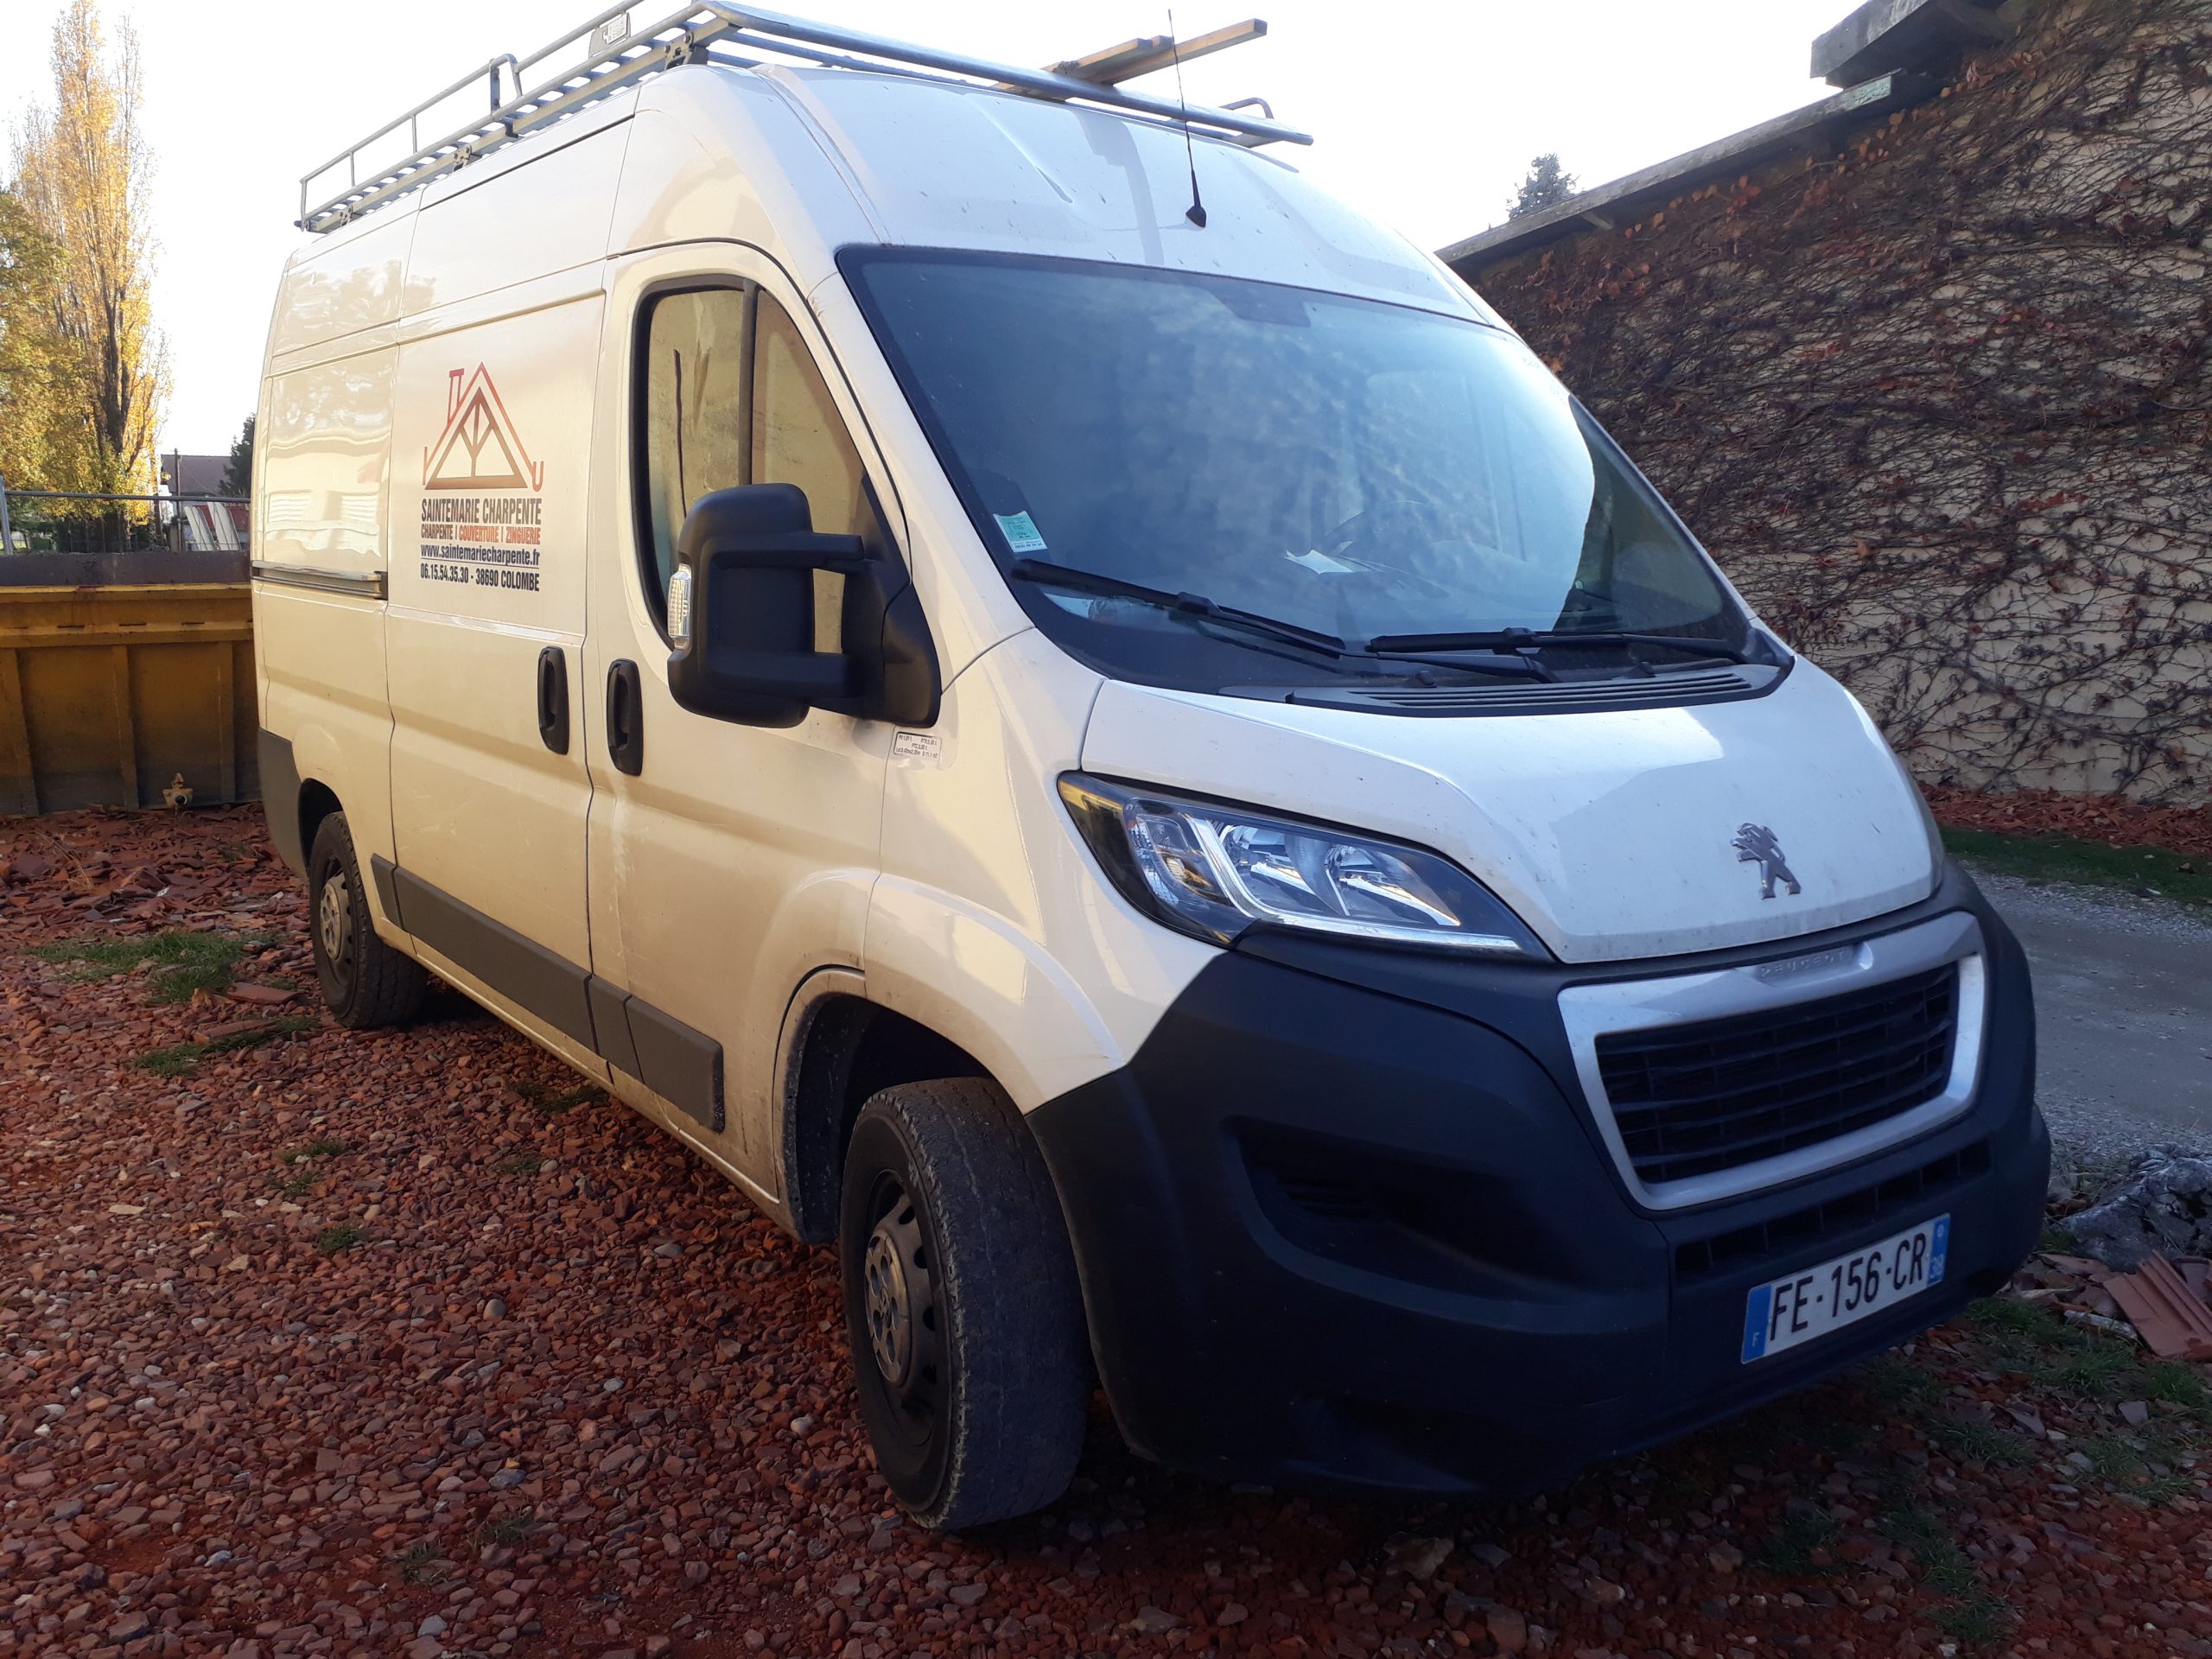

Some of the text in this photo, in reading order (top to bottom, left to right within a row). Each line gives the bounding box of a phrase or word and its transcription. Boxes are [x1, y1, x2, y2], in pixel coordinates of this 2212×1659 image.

[422, 498, 542, 524] SAINTEMARIE CHARPENTE
[421, 524, 453, 540] CHARPENTE
[459, 524, 499, 543] COUVERTURE
[505, 526, 541, 545] ZINGUERIE
[421, 543, 540, 566] www.saintemariecharpente.fr
[420, 563, 468, 583] 06.15.54.35.30
[475, 568, 499, 587] 38690
[501, 570, 540, 592] COLOMBE
[1929, 1253, 1944, 1279] 38
[1770, 1232, 1927, 1341] FE-156-CR
